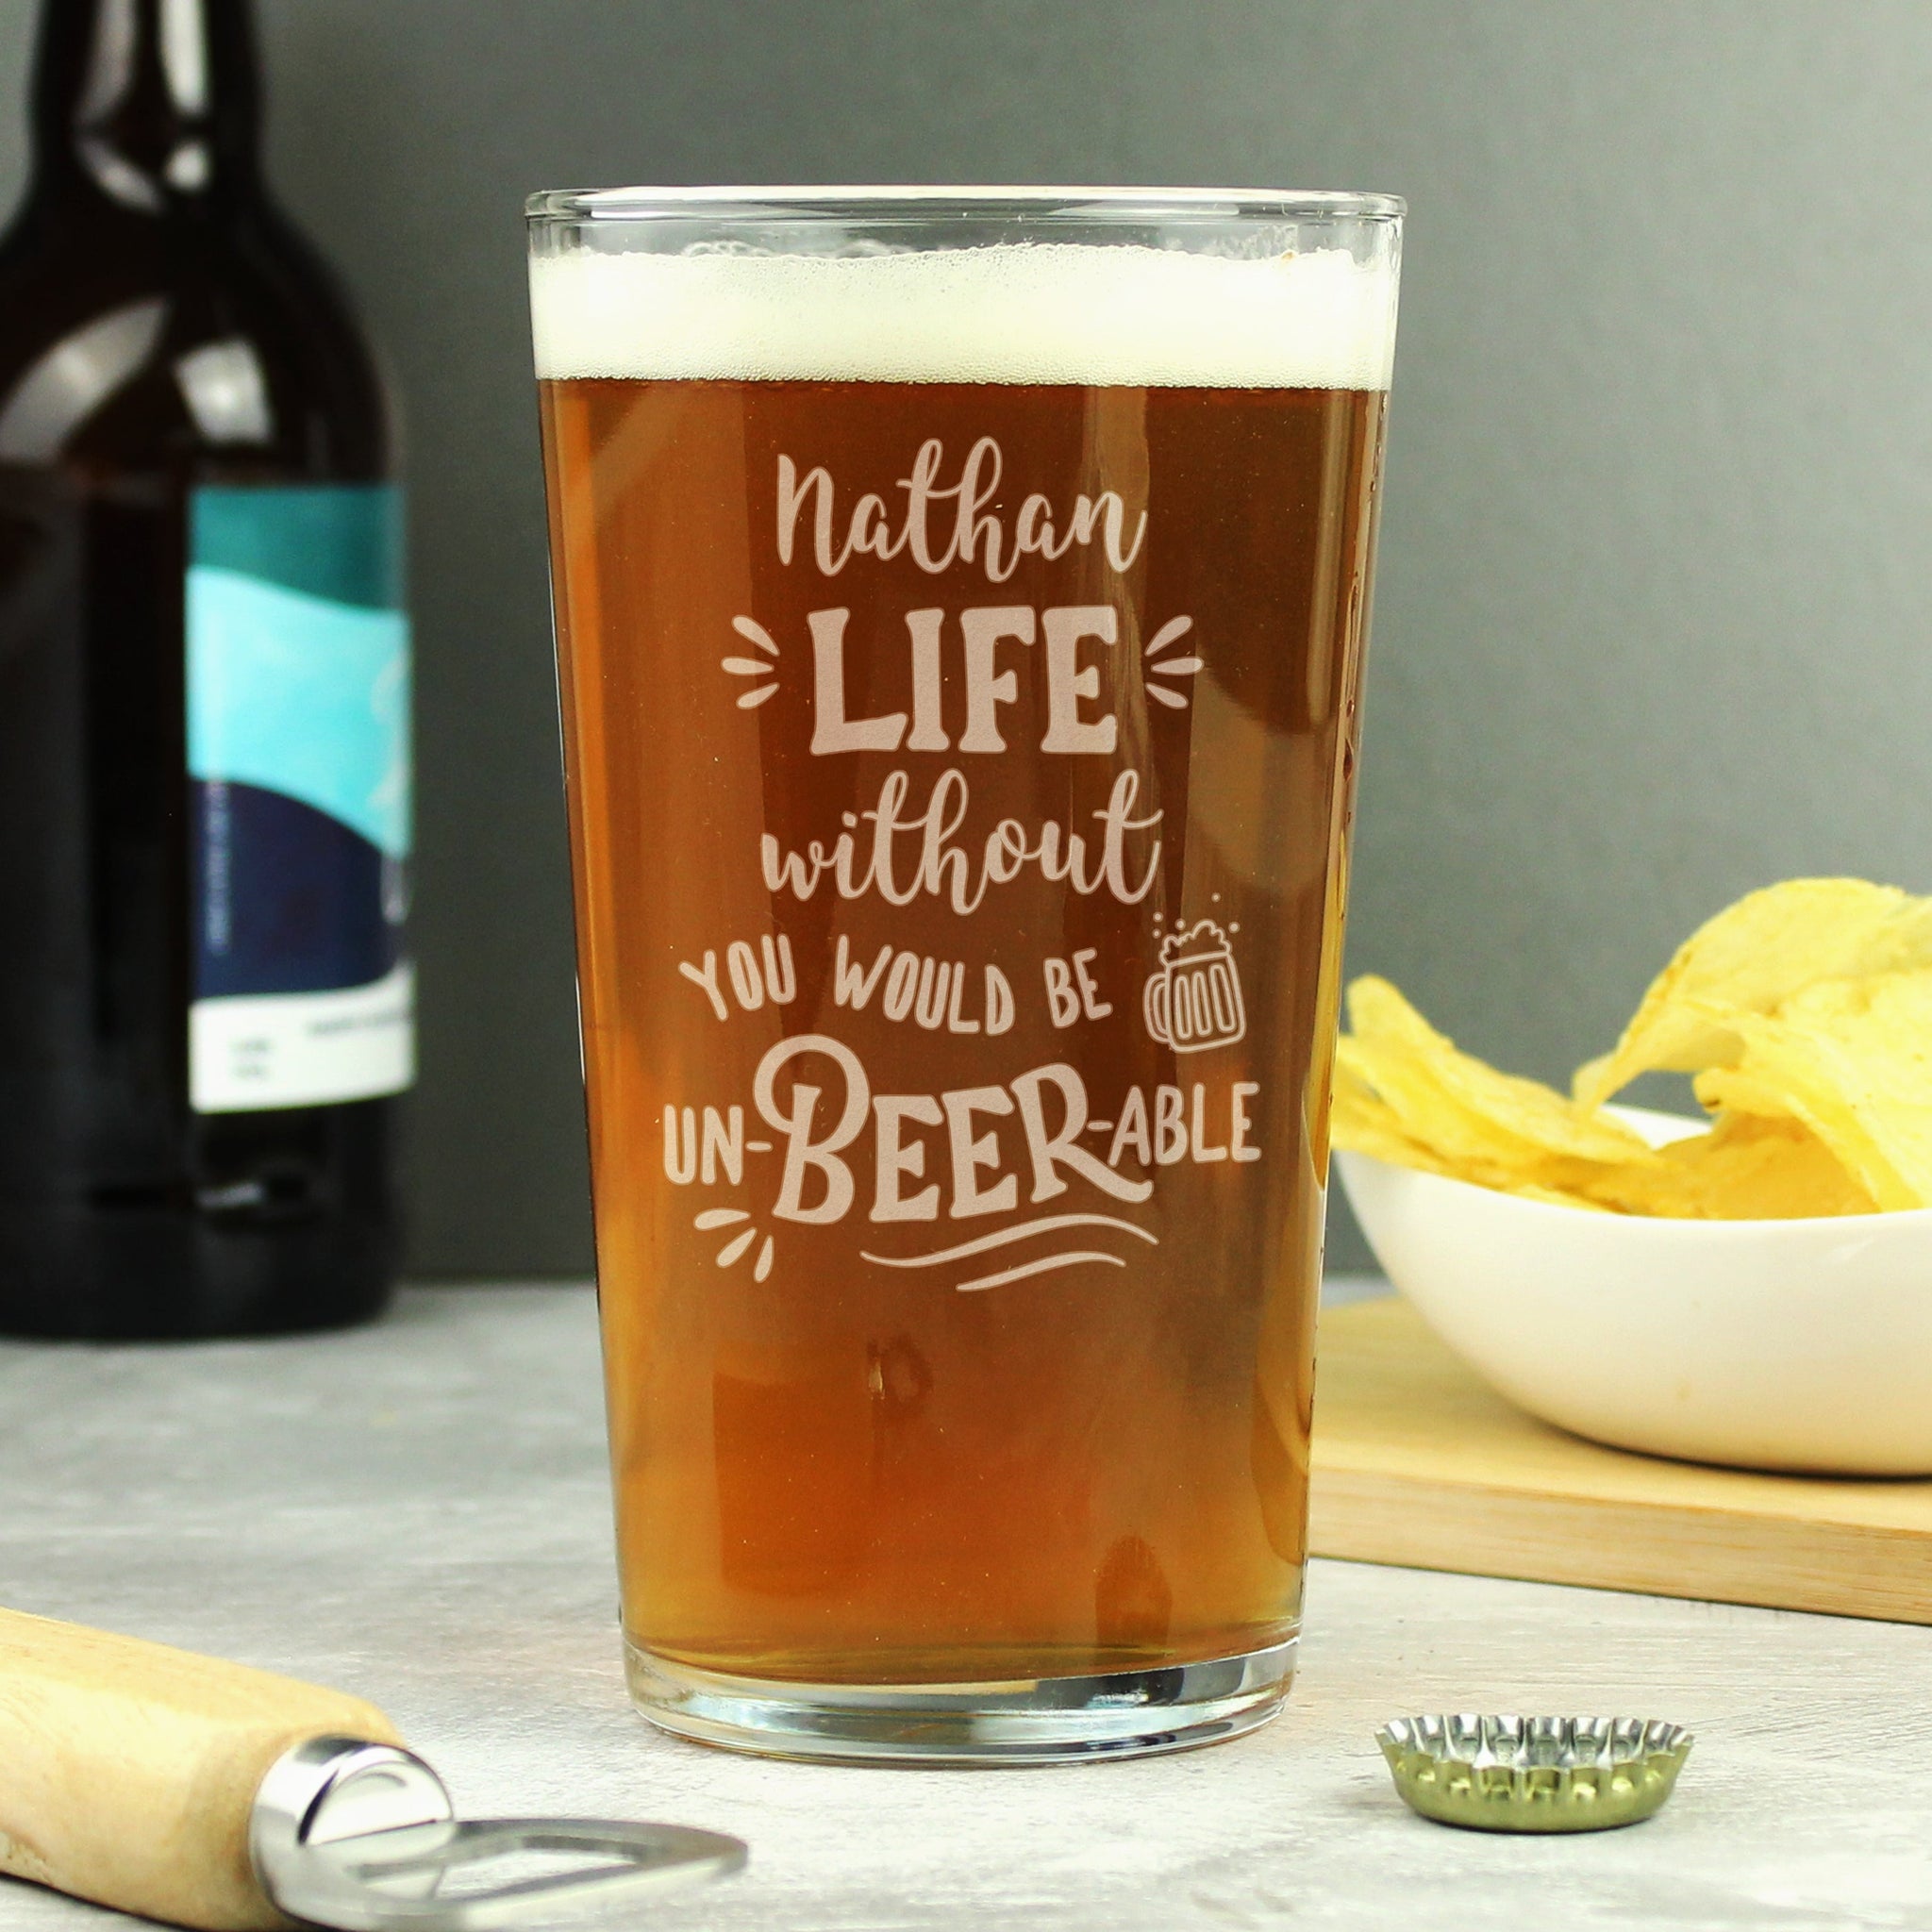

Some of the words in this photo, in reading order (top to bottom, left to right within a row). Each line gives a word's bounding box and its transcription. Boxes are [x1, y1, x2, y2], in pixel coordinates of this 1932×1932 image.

[776, 437, 1148, 582] Nathan
[807, 606, 1119, 756] LIFE
[760, 769, 1165, 915] without
[678, 933, 797, 1023] YOU
[834, 934, 1016, 1036] WOULD
[1042, 946, 1114, 1030] BE
[662, 1034, 1262, 1224] UN-BEER-ABLE
